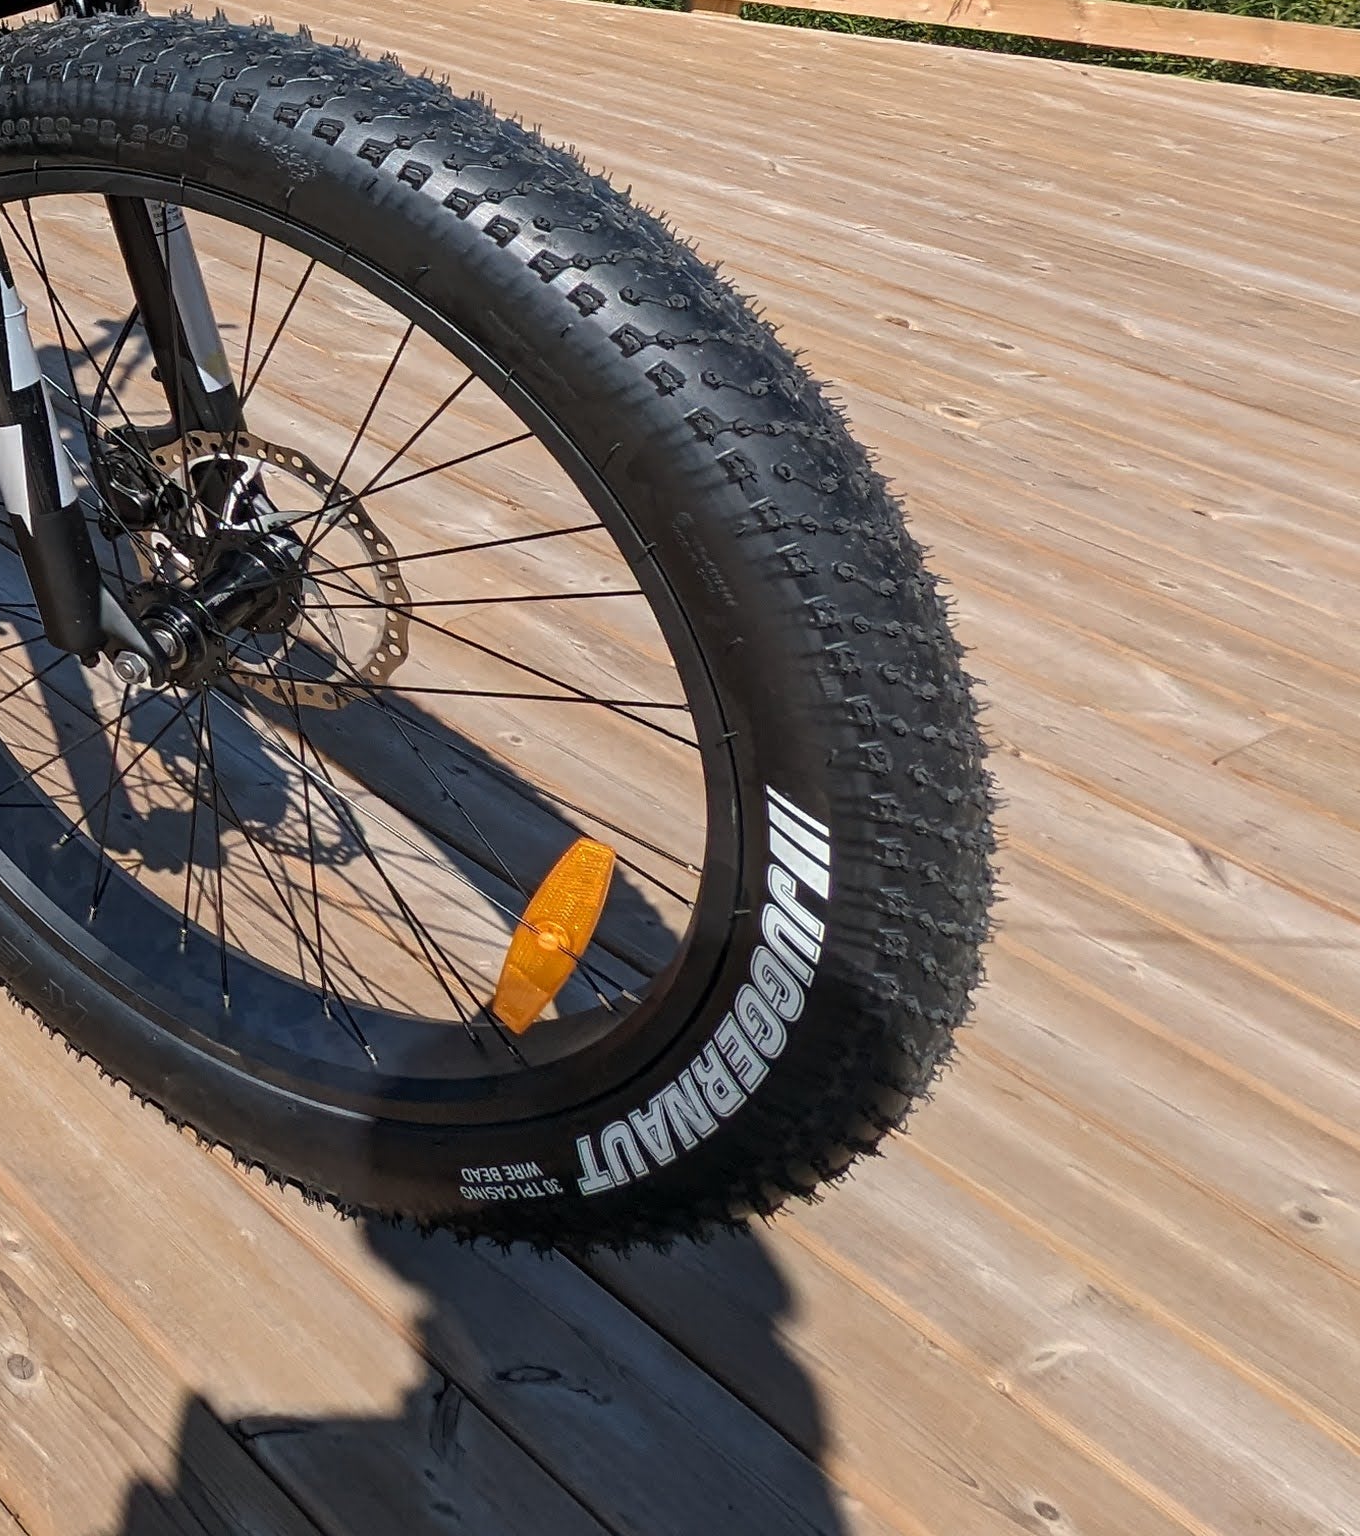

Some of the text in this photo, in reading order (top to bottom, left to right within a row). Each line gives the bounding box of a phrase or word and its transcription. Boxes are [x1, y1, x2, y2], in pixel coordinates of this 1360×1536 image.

[575, 862, 826, 1197] JUGGERNAUT
[460, 1161, 544, 1183] WIRE BEAD
[459, 1177, 564, 1201] 30 TPI CASING
